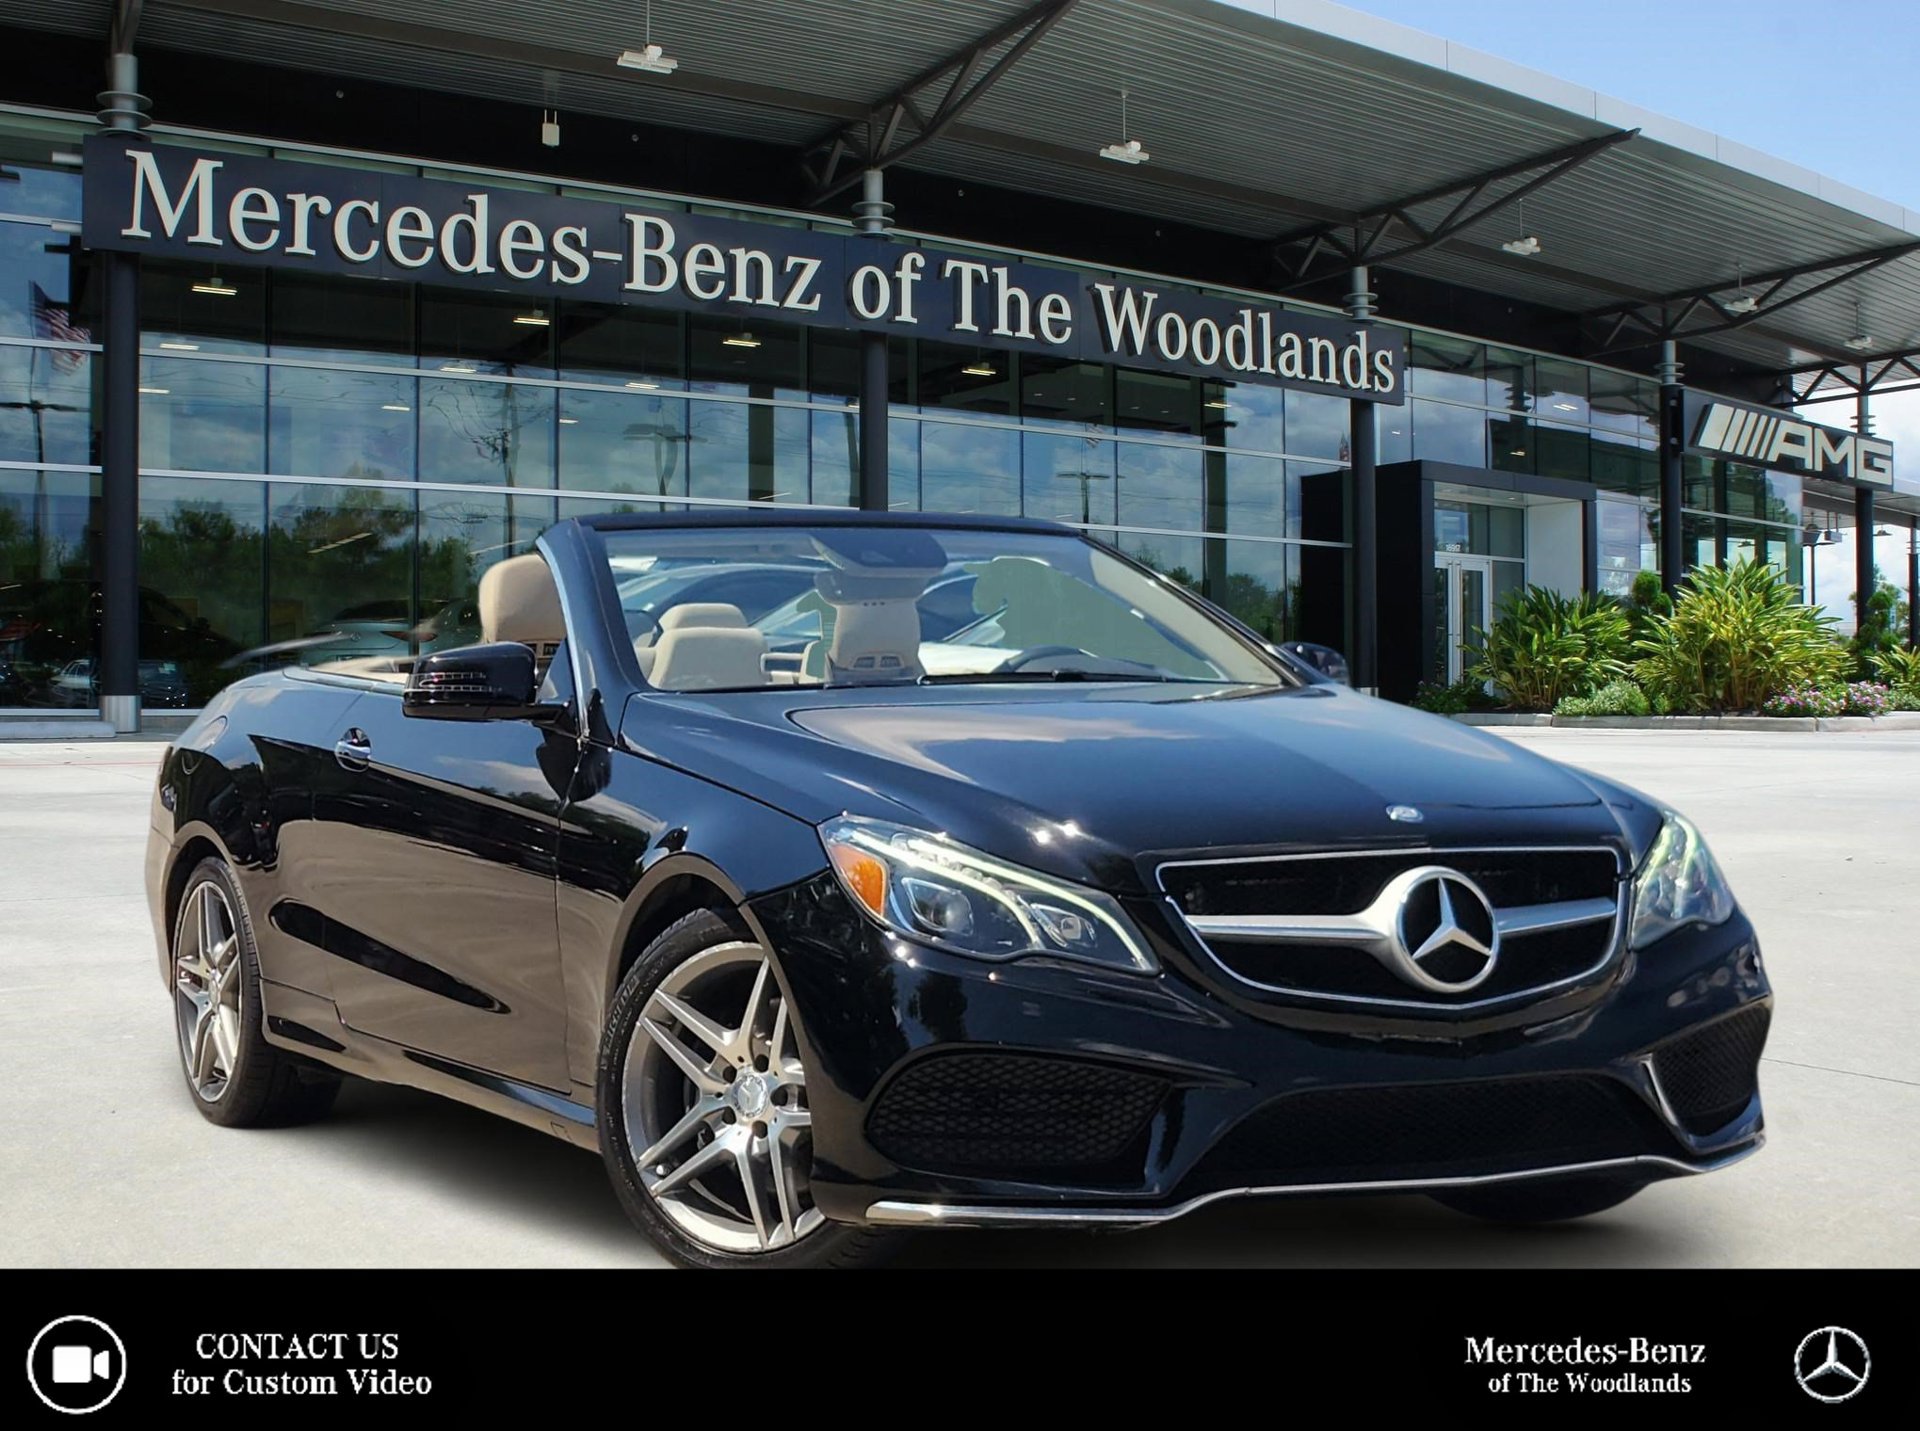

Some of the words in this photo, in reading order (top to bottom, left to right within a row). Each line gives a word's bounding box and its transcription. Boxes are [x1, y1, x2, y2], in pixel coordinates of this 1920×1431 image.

[121, 149, 822, 313] Mercedes-Benz
[851, 252, 925, 324] of
[944, 259, 1072, 344] The
[1094, 282, 1394, 393] Woodlands
[1767, 418, 1893, 486] AMG
